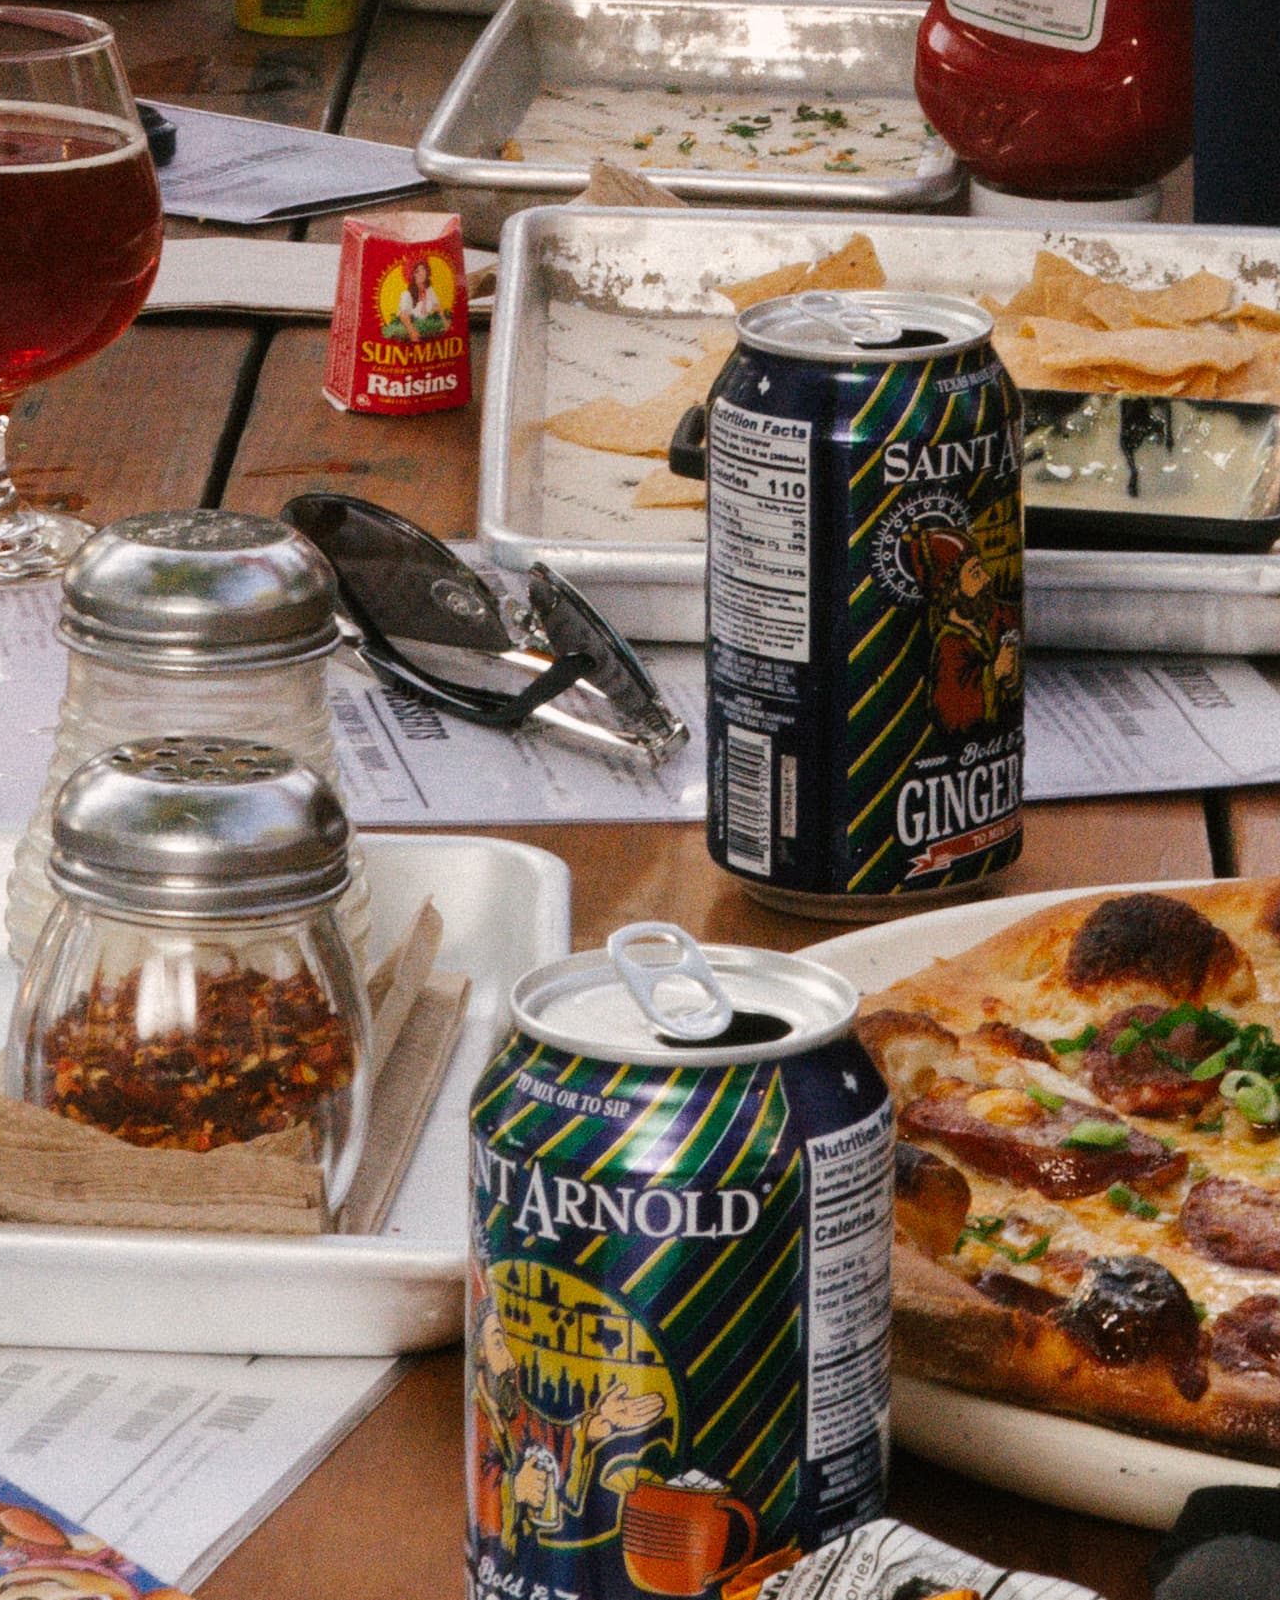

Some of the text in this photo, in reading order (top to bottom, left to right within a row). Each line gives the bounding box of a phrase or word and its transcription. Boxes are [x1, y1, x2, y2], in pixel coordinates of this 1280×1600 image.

[367, 372, 458, 397] Raisins
[762, 420, 807, 438] Facts
[884, 431, 998, 485] SAINT
[768, 479, 805, 499] 110
[959, 735, 1003, 765] Bold
[897, 753, 1019, 846] GINGER
[516, 1072, 632, 1119] TO MIX OR TO SIP
[814, 1123, 881, 1162] Nutrition
[513, 1160, 760, 1241] ARNOLD
[815, 1209, 876, 1242] Calories
[478, 1555, 525, 1598] Bold
